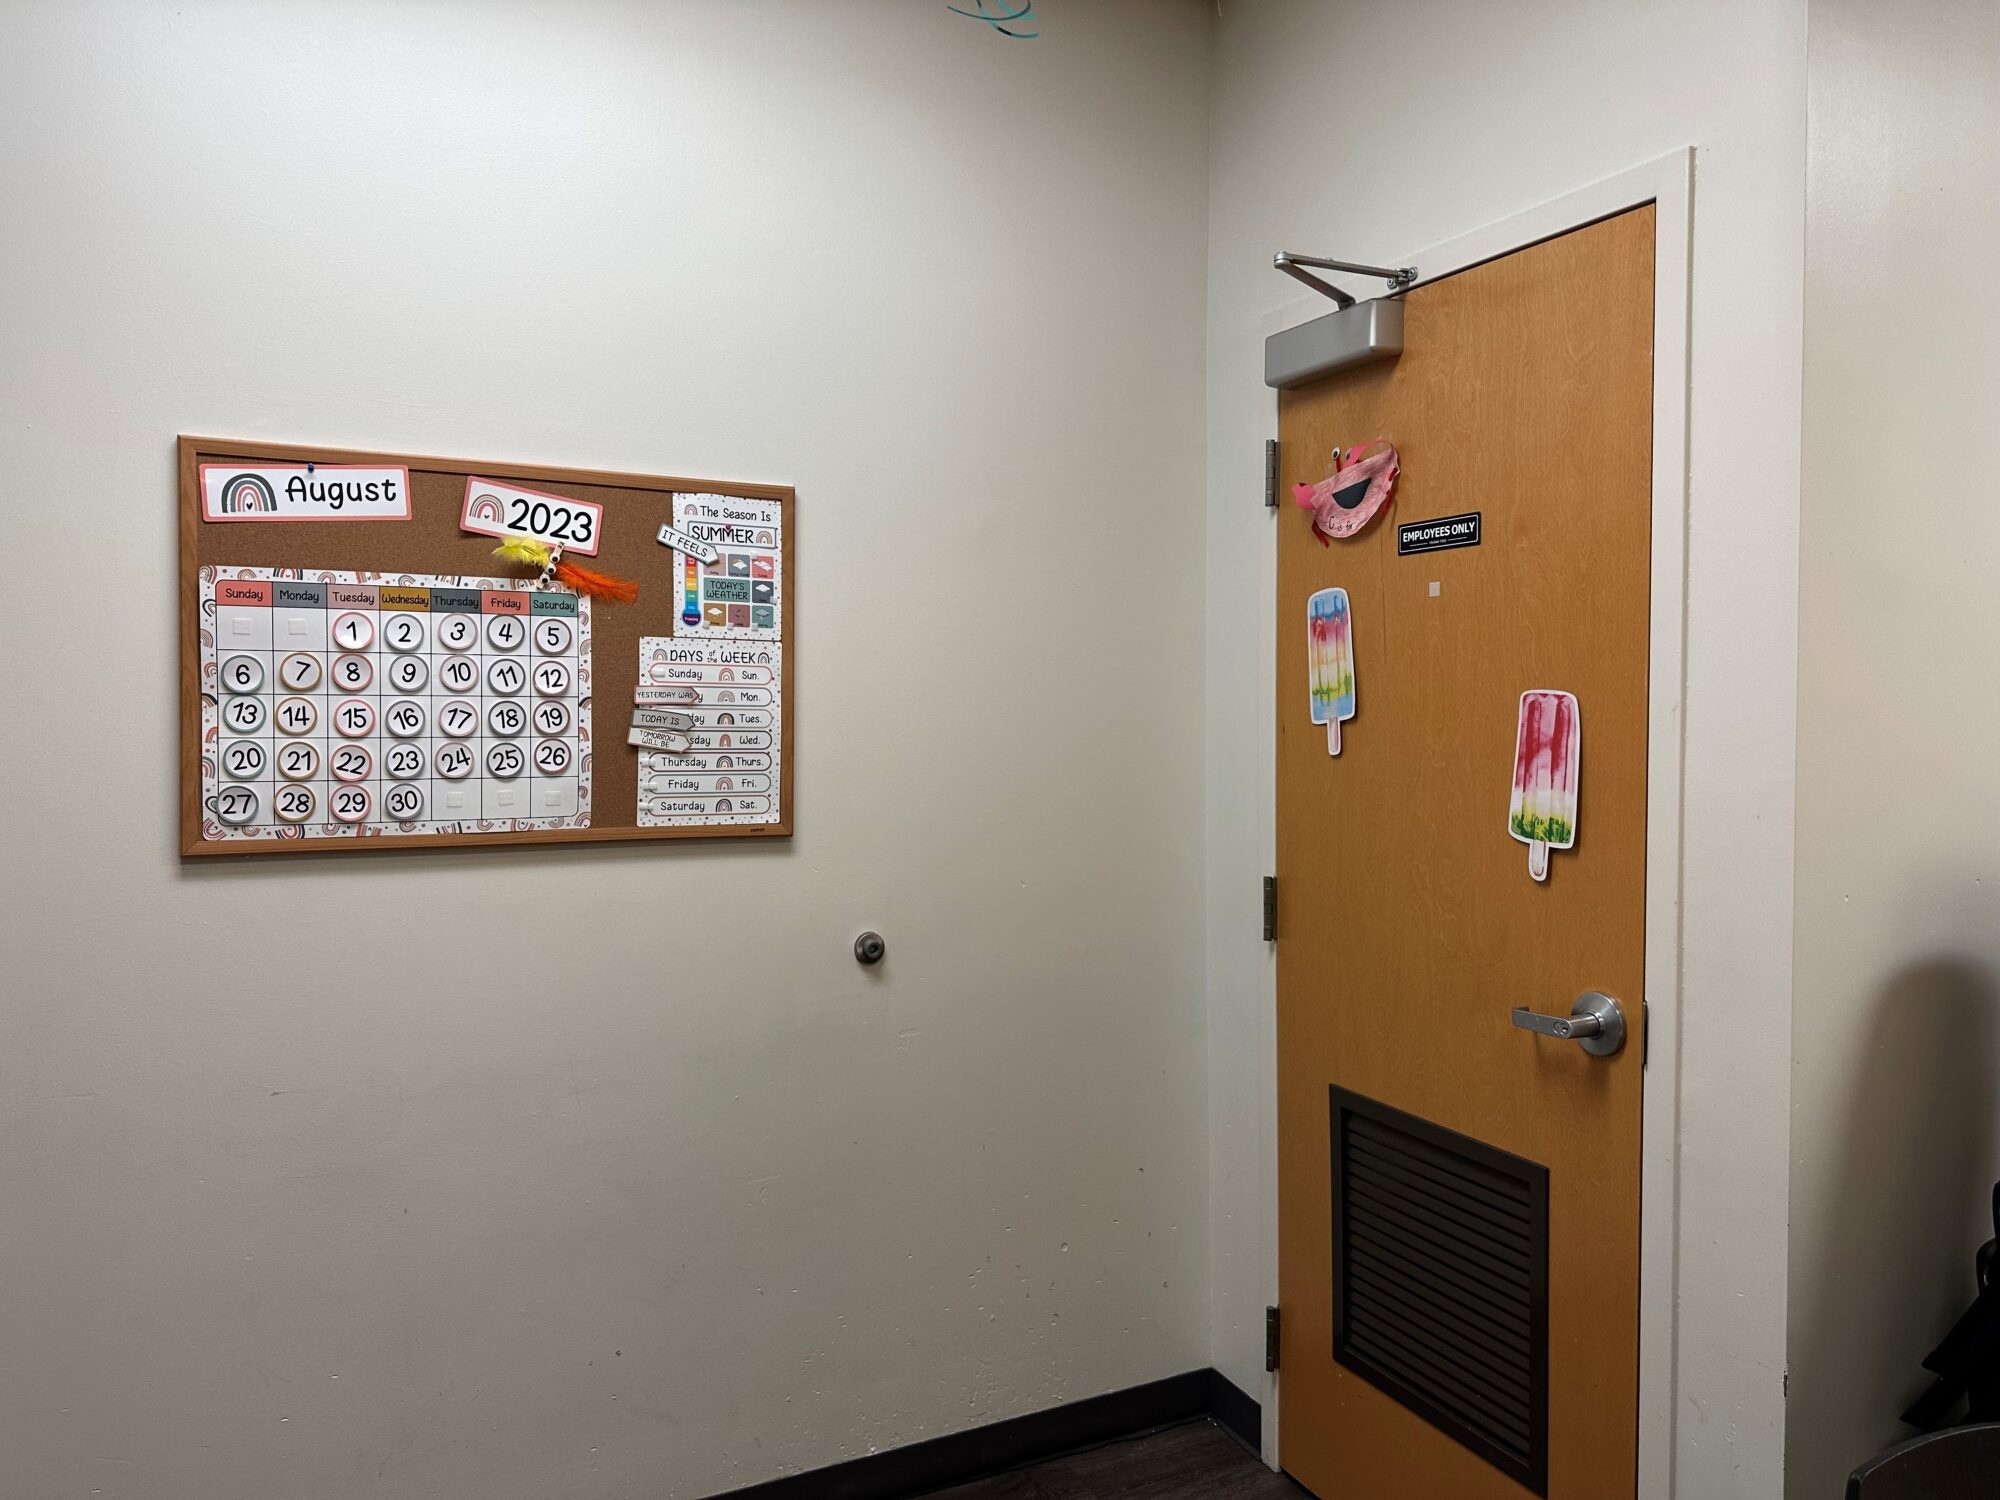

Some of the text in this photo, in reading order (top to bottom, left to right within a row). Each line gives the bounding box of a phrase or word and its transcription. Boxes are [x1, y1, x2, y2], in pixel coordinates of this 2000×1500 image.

[285, 475, 397, 510] August
[507, 498, 593, 543] 2023
[700, 505, 771, 522] The Season Is
[1329, 515, 1334, 529] C
[692, 525, 754, 544] SUMMER
[1402, 521, 1475, 542] EMPLOYEES ONLY
[662, 530, 708, 557] IT FEELS
[710, 581, 745, 591] TODAY'S
[225, 588, 575, 612] Sunday Monday Tuesday Wednesday Thursday Friday Saturday
[706, 590, 748, 600] WEATHER
[346, 621, 560, 646] 1 2 3 4 5
[670, 650, 703, 662] DAYS
[721, 652, 756, 664] WEEK
[235, 660, 563, 688] 6 7 8 9 10 11 12
[668, 669, 760, 681] Sunday Sun.
[741, 692, 761, 702] Mon.
[233, 702, 563, 730] 13 14 15 16 17 18 19
[641, 714, 668, 724] TODAY
[670, 717, 680, 726] IS
[739, 713, 762, 723] Tues.
[640, 730, 676, 742] TOMORROW
[641, 738, 658, 746] WILL
[739, 736, 761, 745] Wed.
[231, 746, 566, 775] 20 21 22 23 24 25 26
[661, 757, 764, 768] Thursday Thurs.
[668, 778, 757, 790] Friday Fri.
[222, 790, 418, 815] 27 28 29 30
[660, 800, 758, 812] Saturday Sat.
